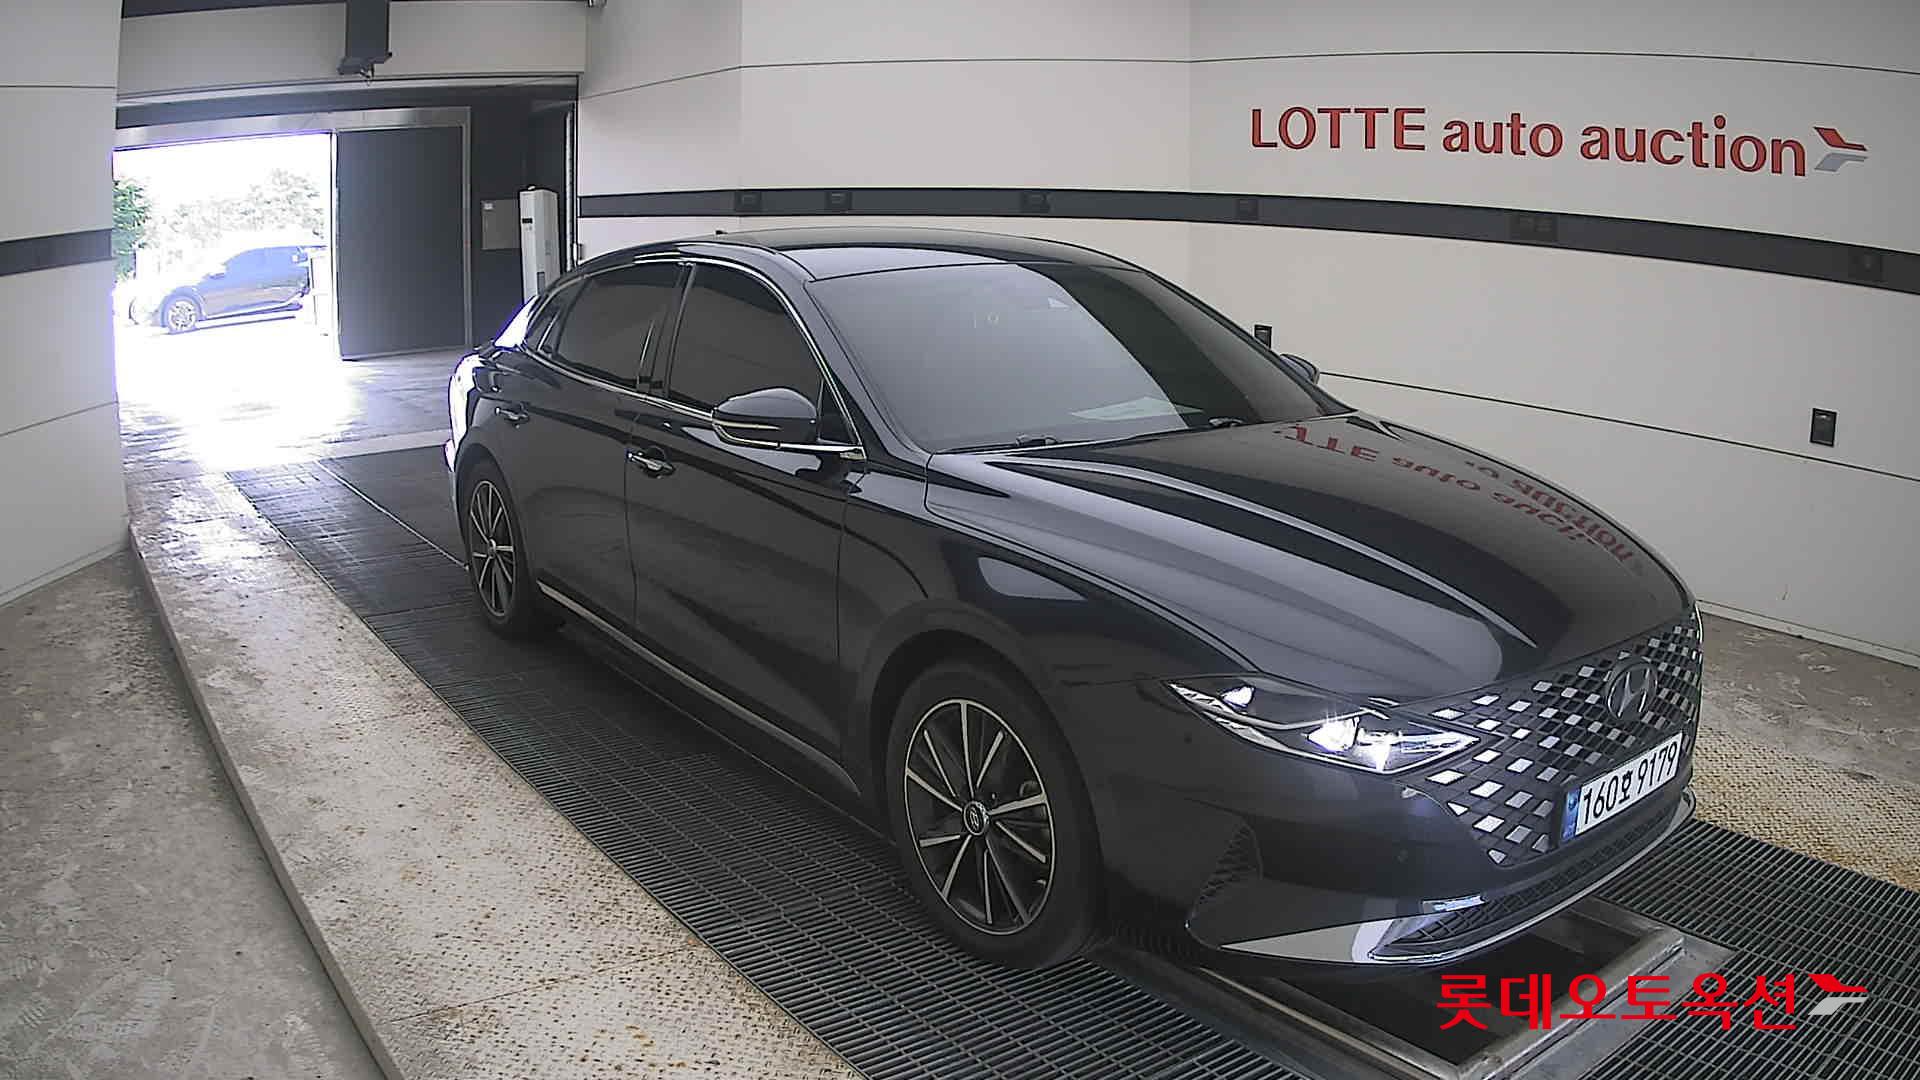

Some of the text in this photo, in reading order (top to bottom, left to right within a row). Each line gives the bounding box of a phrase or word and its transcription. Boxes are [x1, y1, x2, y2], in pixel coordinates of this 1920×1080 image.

[1250, 107, 1807, 178] LOTTE auto auction
[1584, 741, 1678, 825] 160호 9179
